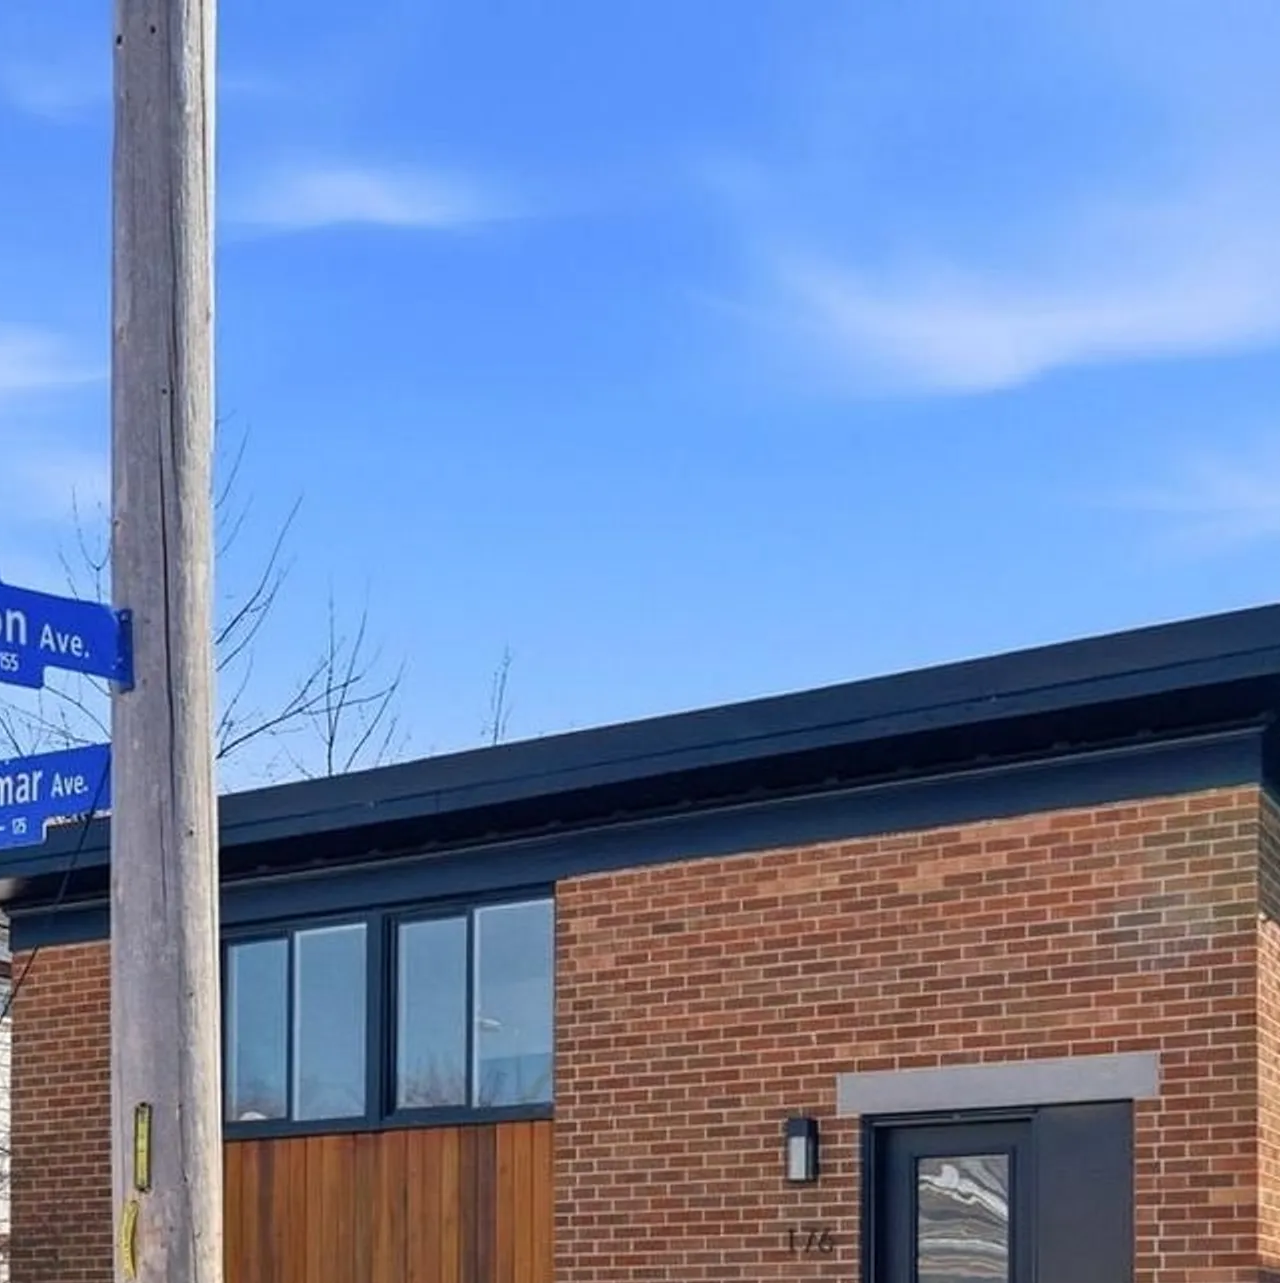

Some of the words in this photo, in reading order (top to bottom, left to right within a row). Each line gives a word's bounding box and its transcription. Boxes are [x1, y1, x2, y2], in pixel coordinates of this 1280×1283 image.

[39, 623, 91, 659] Ave.
[50, 771, 89, 798] Ave.
[788, 1227, 834, 1254] 176
